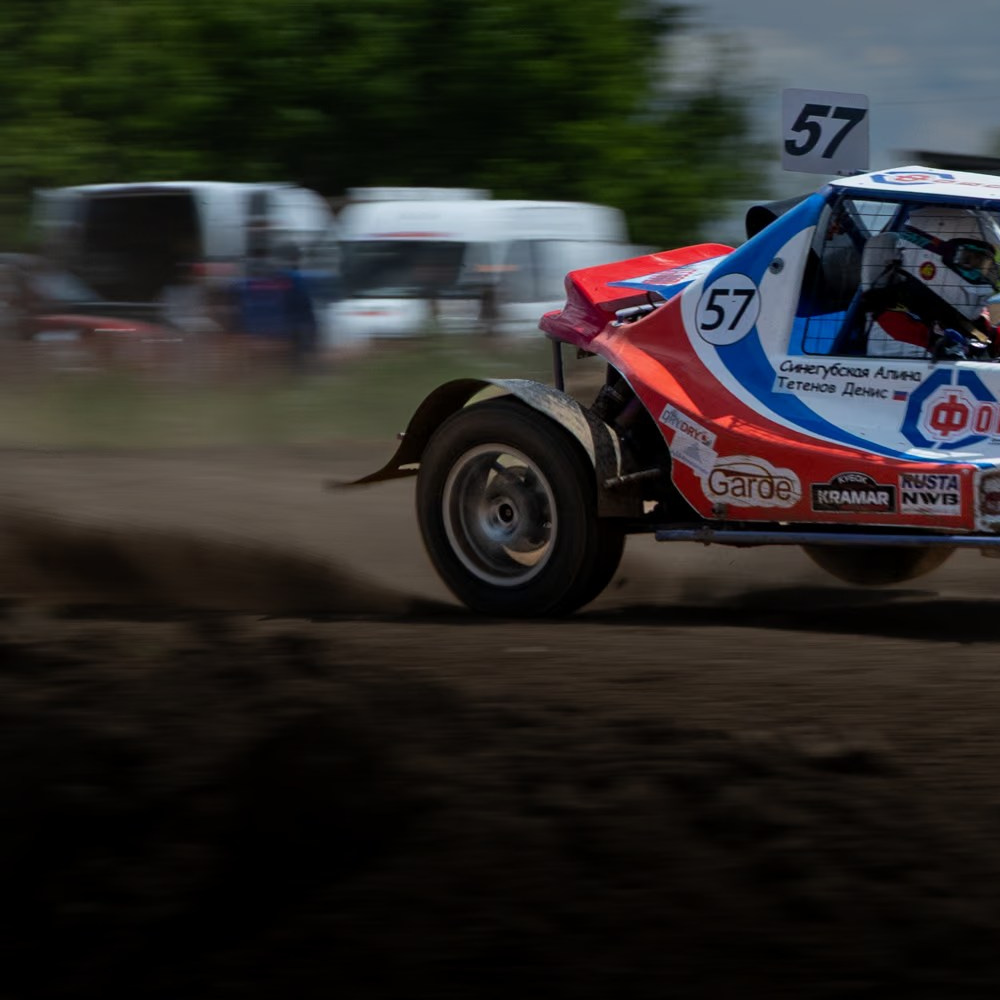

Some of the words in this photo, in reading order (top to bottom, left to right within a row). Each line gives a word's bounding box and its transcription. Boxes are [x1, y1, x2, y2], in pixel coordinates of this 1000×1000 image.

[784, 103, 868, 159] 57
[700, 288, 756, 331] 57
[779, 360, 870, 380] Синегубская
[873, 366, 922, 382] Алина
[777, 376, 836, 394] Тетенов
[841, 382, 889, 399] Денис
[708, 468, 792, 501] Garde
[901, 474, 958, 490] RUSTA
[817, 490, 890, 506] KRAMAR
[902, 493, 958, 506] NWB
